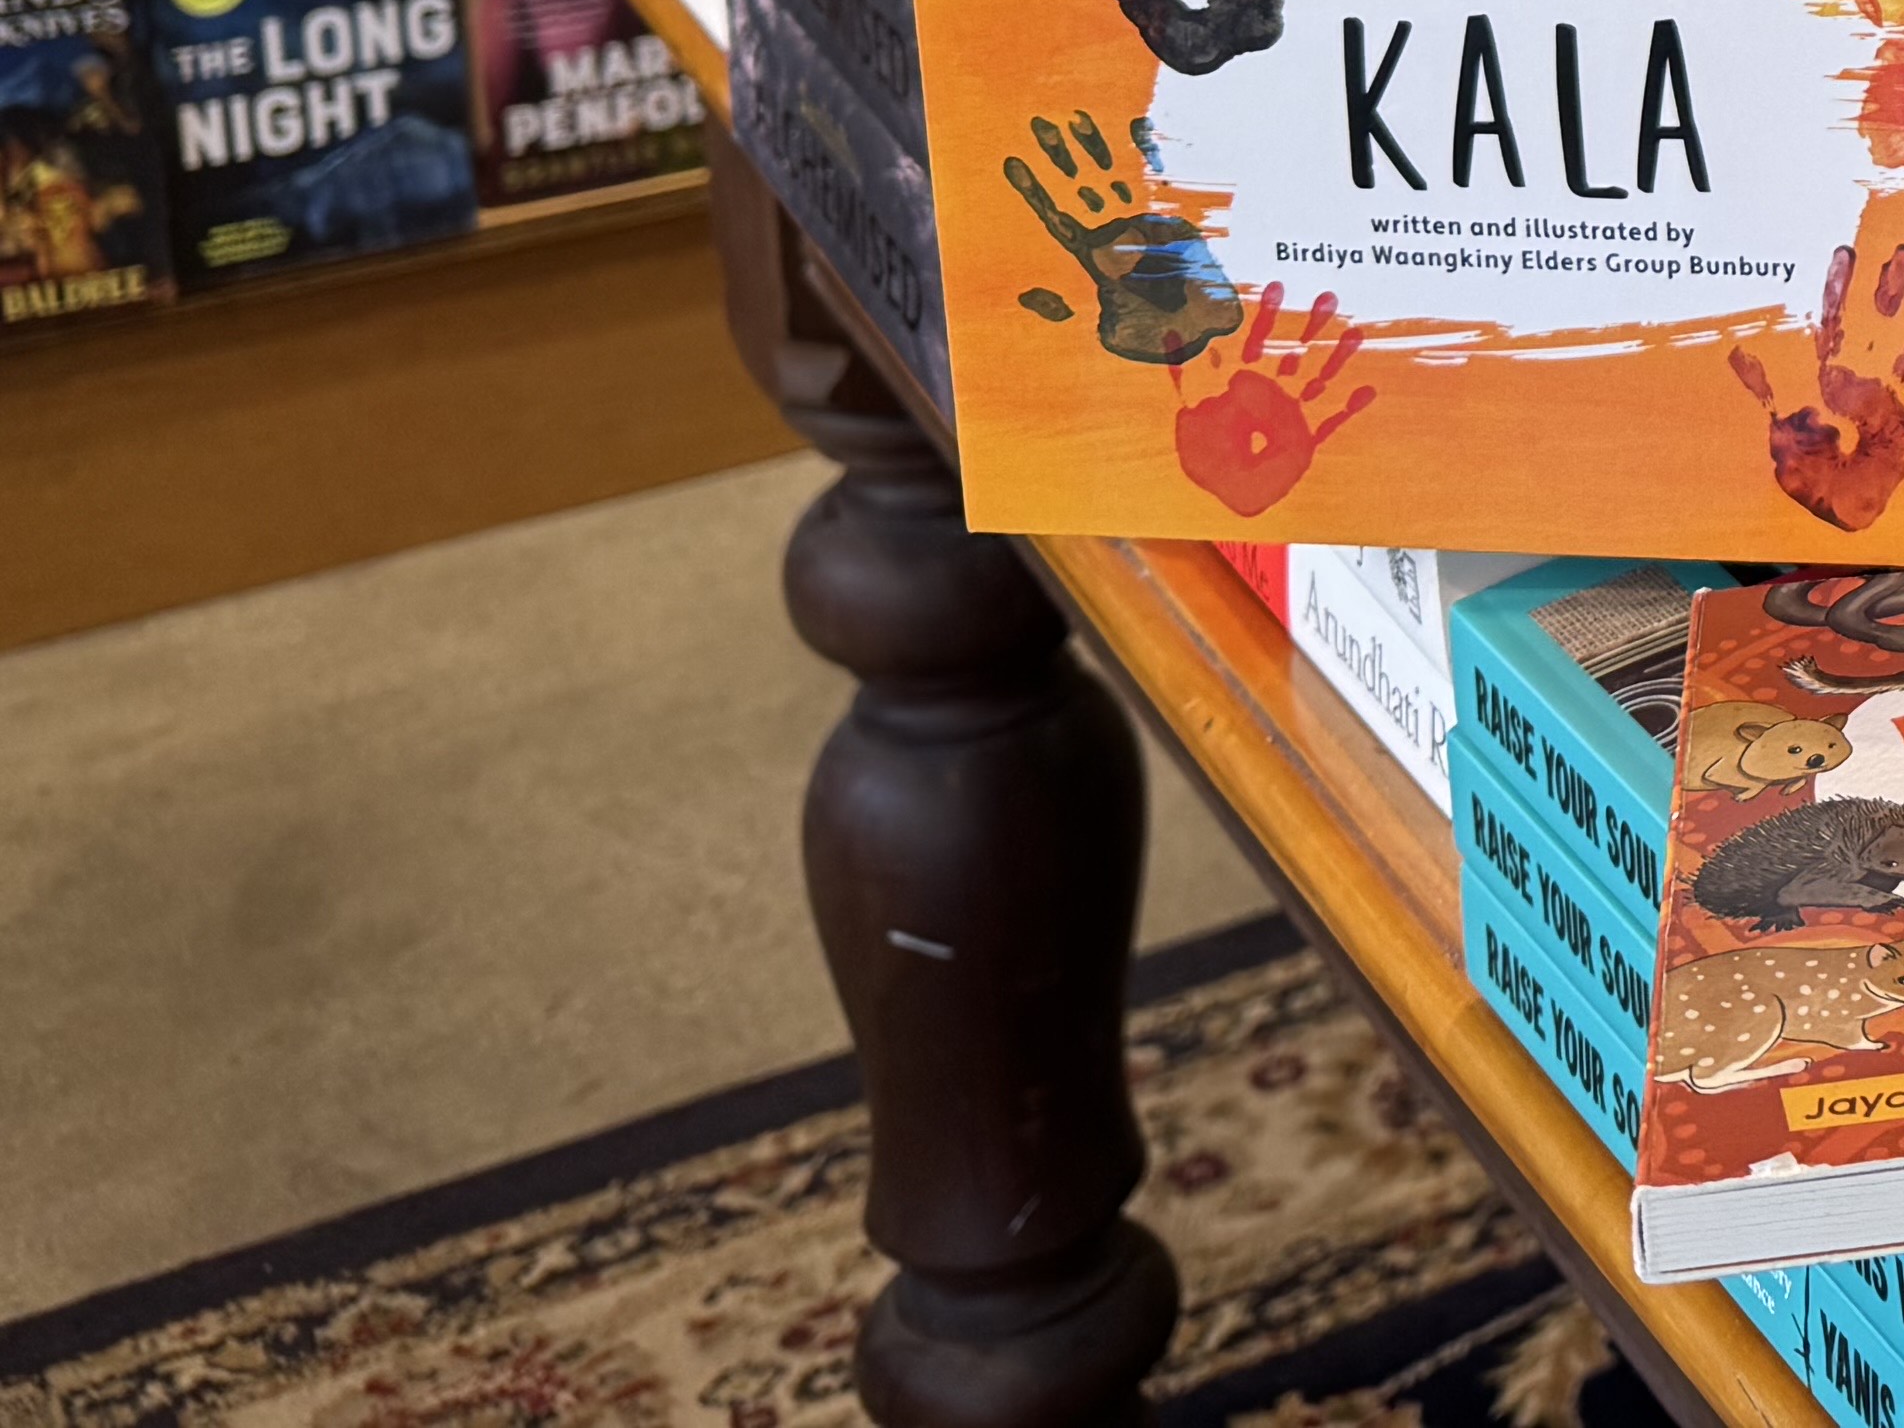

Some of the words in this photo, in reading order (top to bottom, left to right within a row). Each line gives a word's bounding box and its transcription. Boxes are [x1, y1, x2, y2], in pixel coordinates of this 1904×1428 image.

[172, 37, 252, 84] THE
[1343, 13, 1711, 199] KALA
[177, 67, 401, 172] NIGHT
[1276, 242, 1364, 265] Birdiya
[1371, 246, 1513, 273] Waangkiny
[1522, 249, 1597, 272] Elders
[1605, 253, 1681, 279] Group
[1690, 256, 1795, 282] Bunbury
[1371, 215, 1462, 235] written
[1470, 217, 1516, 238] and
[1525, 217, 1657, 241] illustrated
[1667, 222, 1695, 246] by
[1305, 570, 1420, 748] Arundhati
[1474, 666, 1537, 780] RAISE
[1541, 735, 1602, 850] YOUR
[1606, 806, 1663, 911] SOUL
